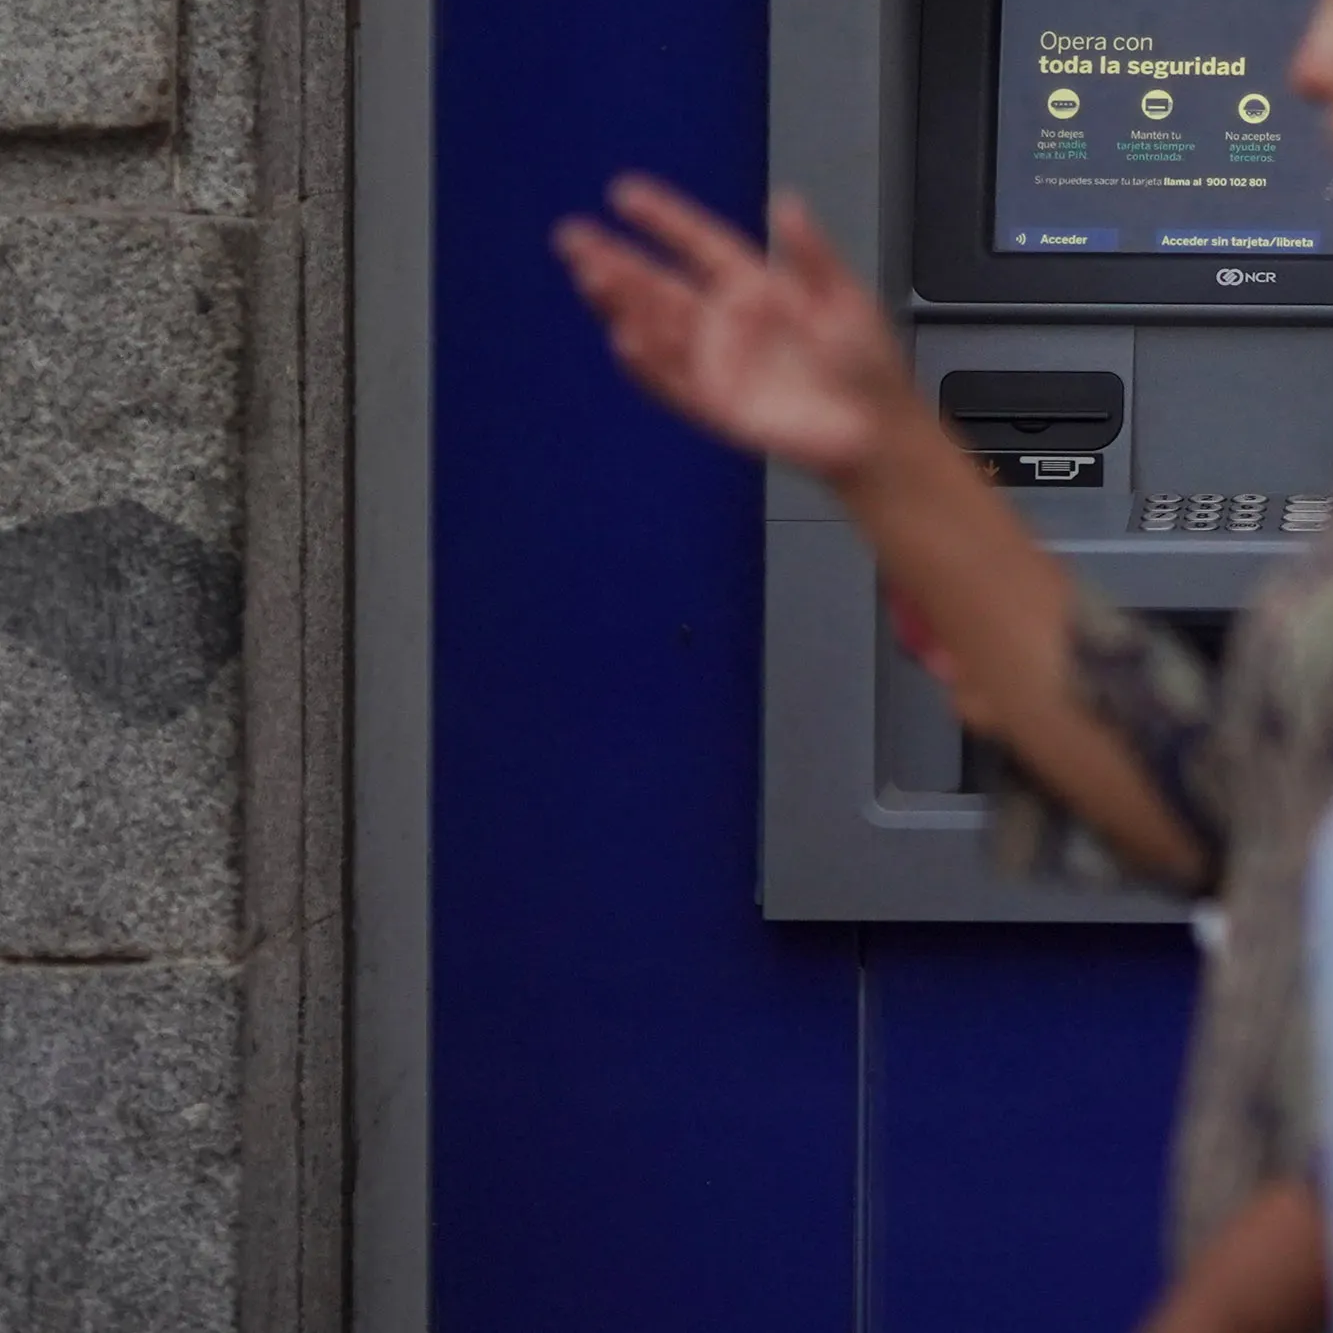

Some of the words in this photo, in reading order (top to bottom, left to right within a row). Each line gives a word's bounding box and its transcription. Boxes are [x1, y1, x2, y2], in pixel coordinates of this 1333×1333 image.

[1040, 30, 1107, 54] Opera
[1112, 35, 1153, 52] con
[1039, 55, 1093, 74] toda
[1100, 56, 1121, 74] la
[1127, 57, 1246, 79] seguridad
[1041, 129, 1056, 138] No
[1057, 129, 1084, 140] dejes
[1171, 131, 1182, 140] tu
[1225, 131, 1240, 141] No
[1241, 132, 1281, 143] aceptes
[1037, 140, 1057, 150] que
[1058, 140, 1088, 149] nadie
[1116, 141, 1152, 153] tarjeta
[1153, 141, 1196, 152] siempre
[1229, 143, 1261, 154] ayuda
[1263, 143, 1277, 152] de
[1058, 177, 1092, 188] puedes
[1132, 177, 1162, 188] tarjeta
[1163, 177, 1191, 187] llama
[1206, 177, 1228, 187] 900
[1229, 178, 1247, 187] 102
[1248, 178, 1267, 187] 801
[1039, 233, 1088, 245] Acceder
[1161, 235, 1209, 246] Acceder
[1211, 236, 1229, 247] sin
[1231, 236, 1314, 250] tarjeta/libreta
[1244, 272, 1277, 283] NCR
